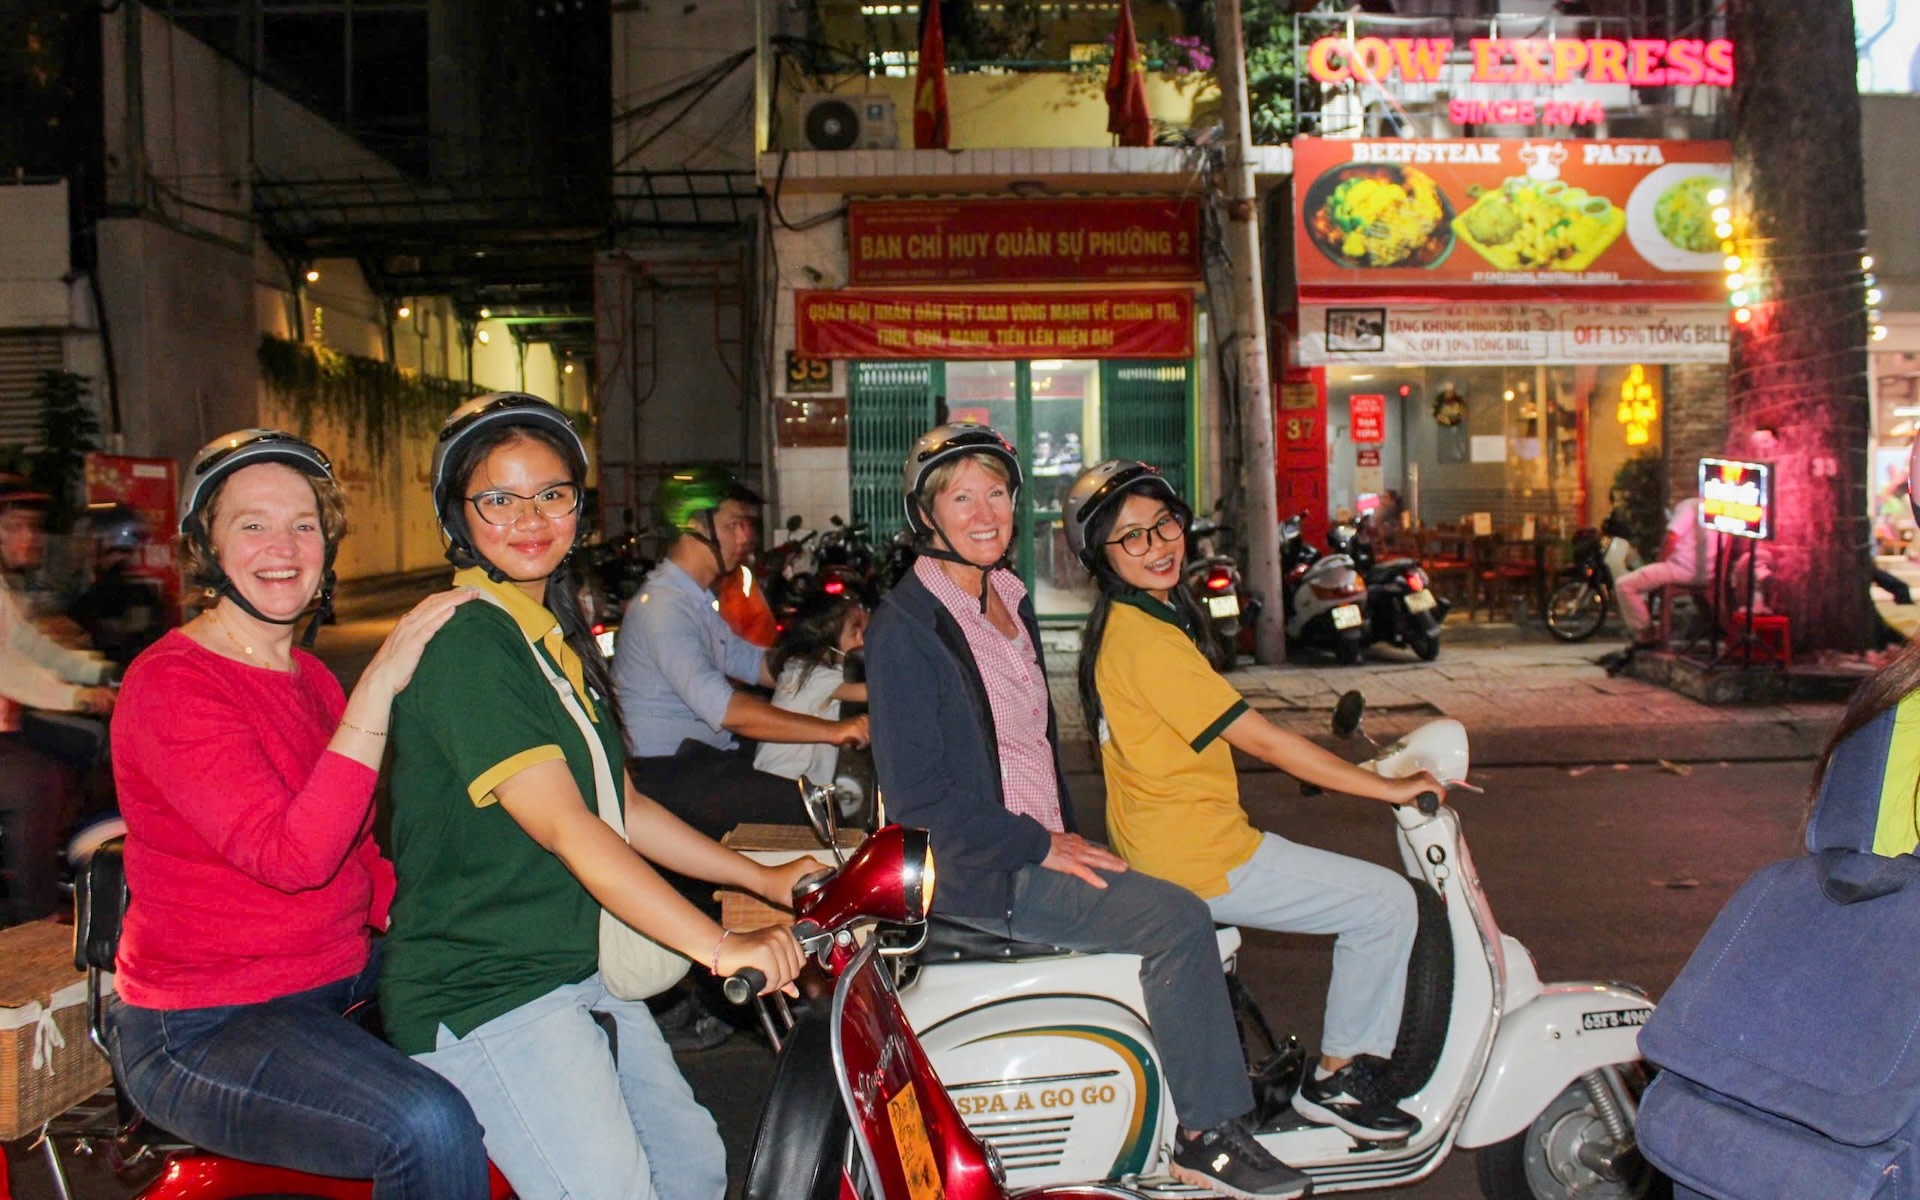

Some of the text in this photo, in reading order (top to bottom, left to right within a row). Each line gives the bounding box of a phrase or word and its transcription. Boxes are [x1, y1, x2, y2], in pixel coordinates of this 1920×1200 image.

[1307, 35, 1735, 87] COW EXPRESS
[1449, 99, 1605, 125] SINCE 2014
[1351, 142, 1665, 165] BEEFSTEAK PASTA
[861, 234, 902, 260] BAN
[907, 225, 943, 260] CHỈ
[949, 233, 990, 257] HUY
[996, 226, 1050, 257] QUÂN
[1177, 230, 1189, 254] 2
[976, 303, 1008, 321] NAM
[1422, 339, 1441, 352] OFF
[1506, 338, 1530, 352] BILL
[1574, 324, 1602, 344] OFF
[1608, 324, 1646, 345] 15%
[790, 357, 829, 380] 35
[1287, 418, 1315, 440] 37
[952, 1085, 1116, 1116] SPA A GO GO
